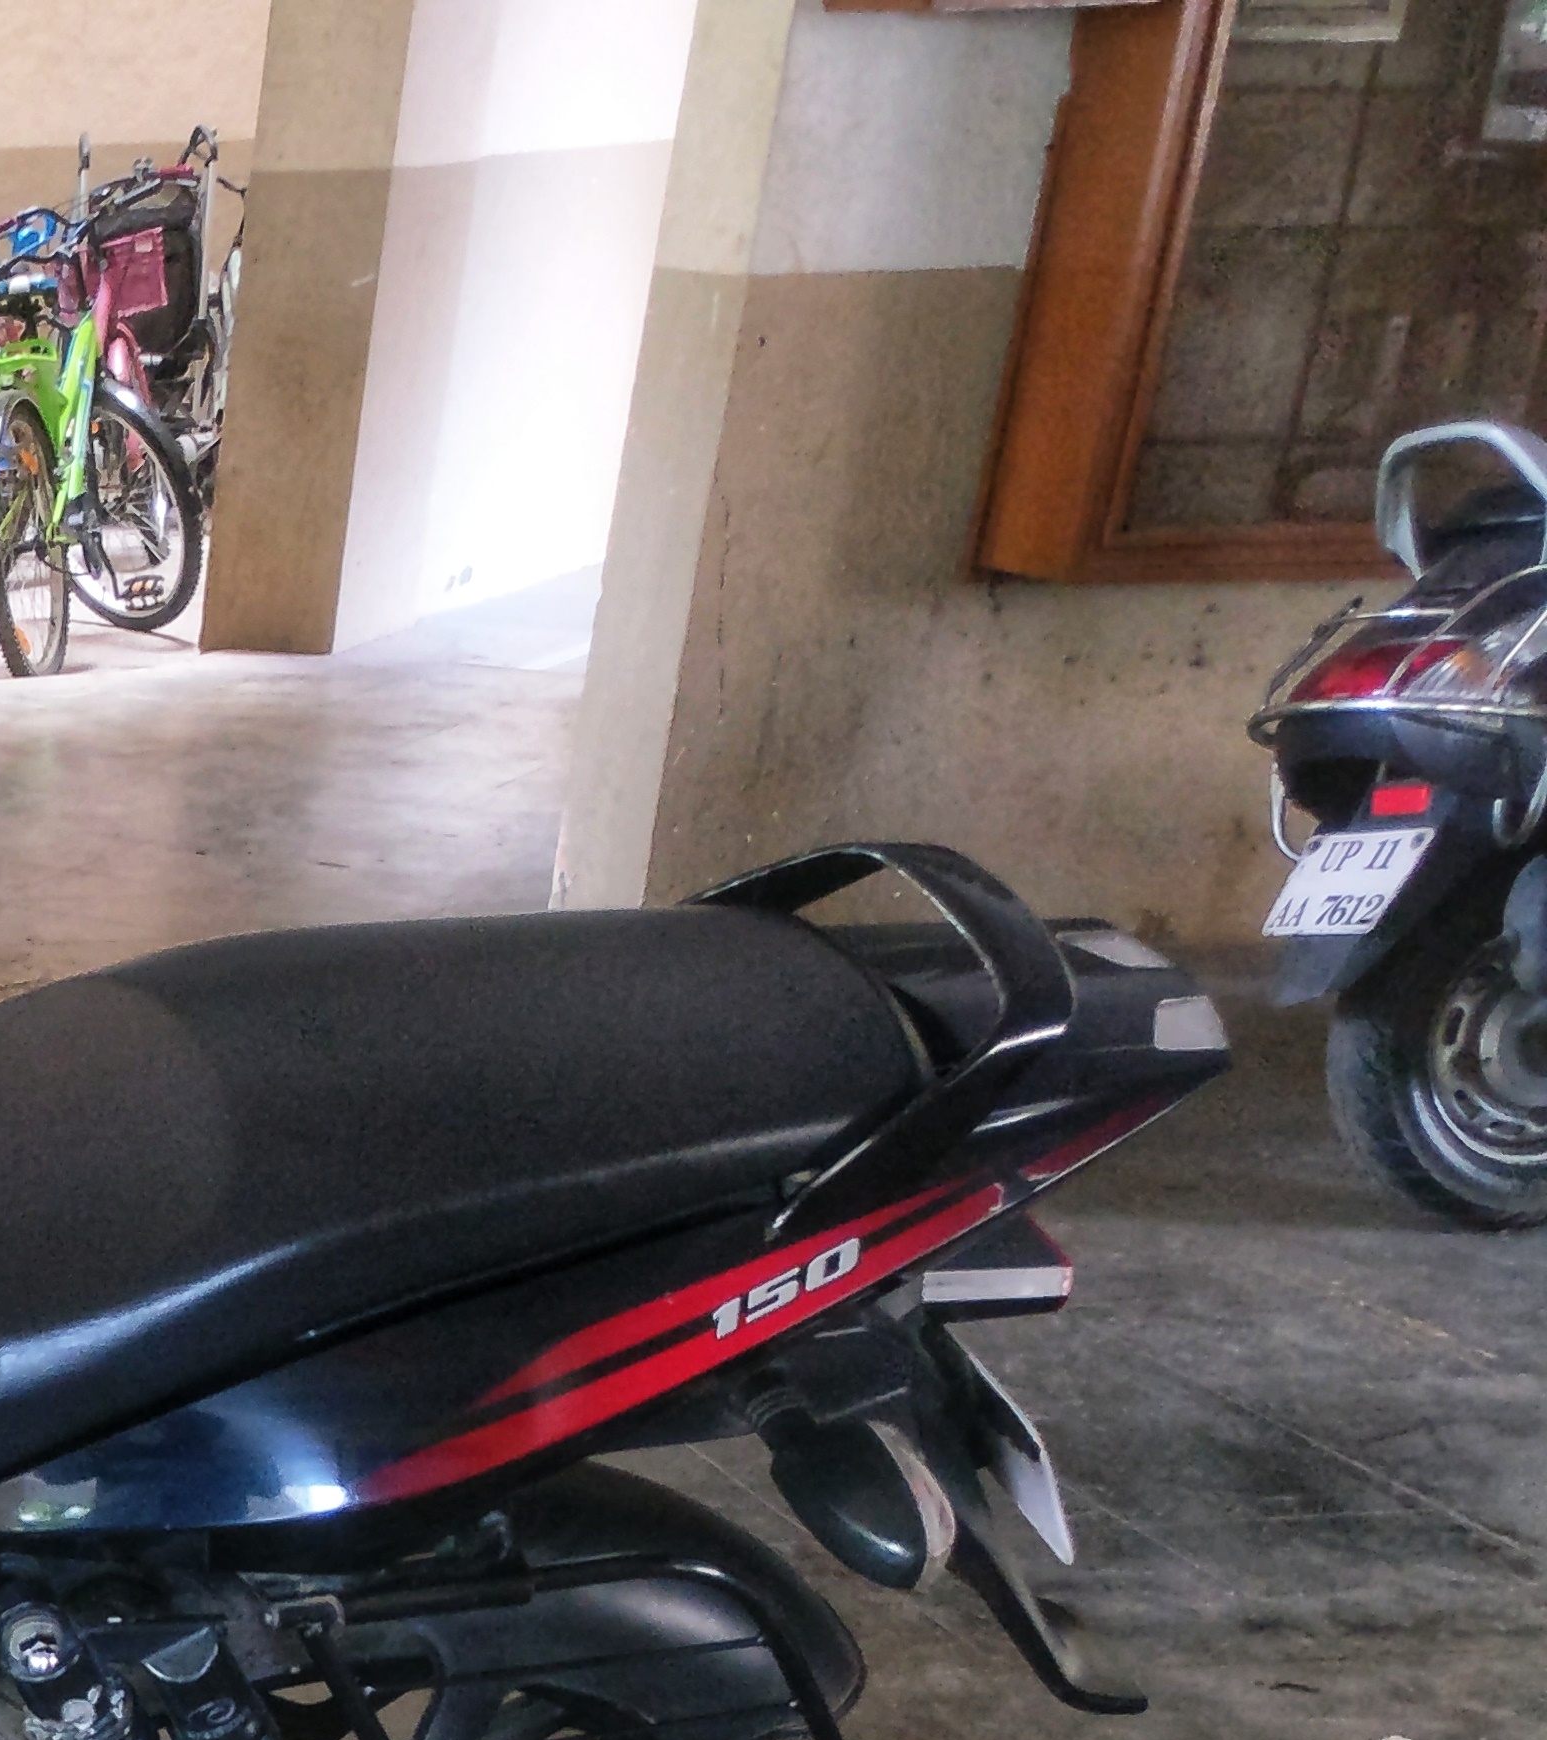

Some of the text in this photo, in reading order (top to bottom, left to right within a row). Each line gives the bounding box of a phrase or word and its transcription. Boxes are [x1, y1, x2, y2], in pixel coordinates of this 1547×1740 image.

[1319, 838, 1402, 873] UP 11
[1270, 894, 1385, 928] AA 7612
[711, 1236, 861, 1341] 150
